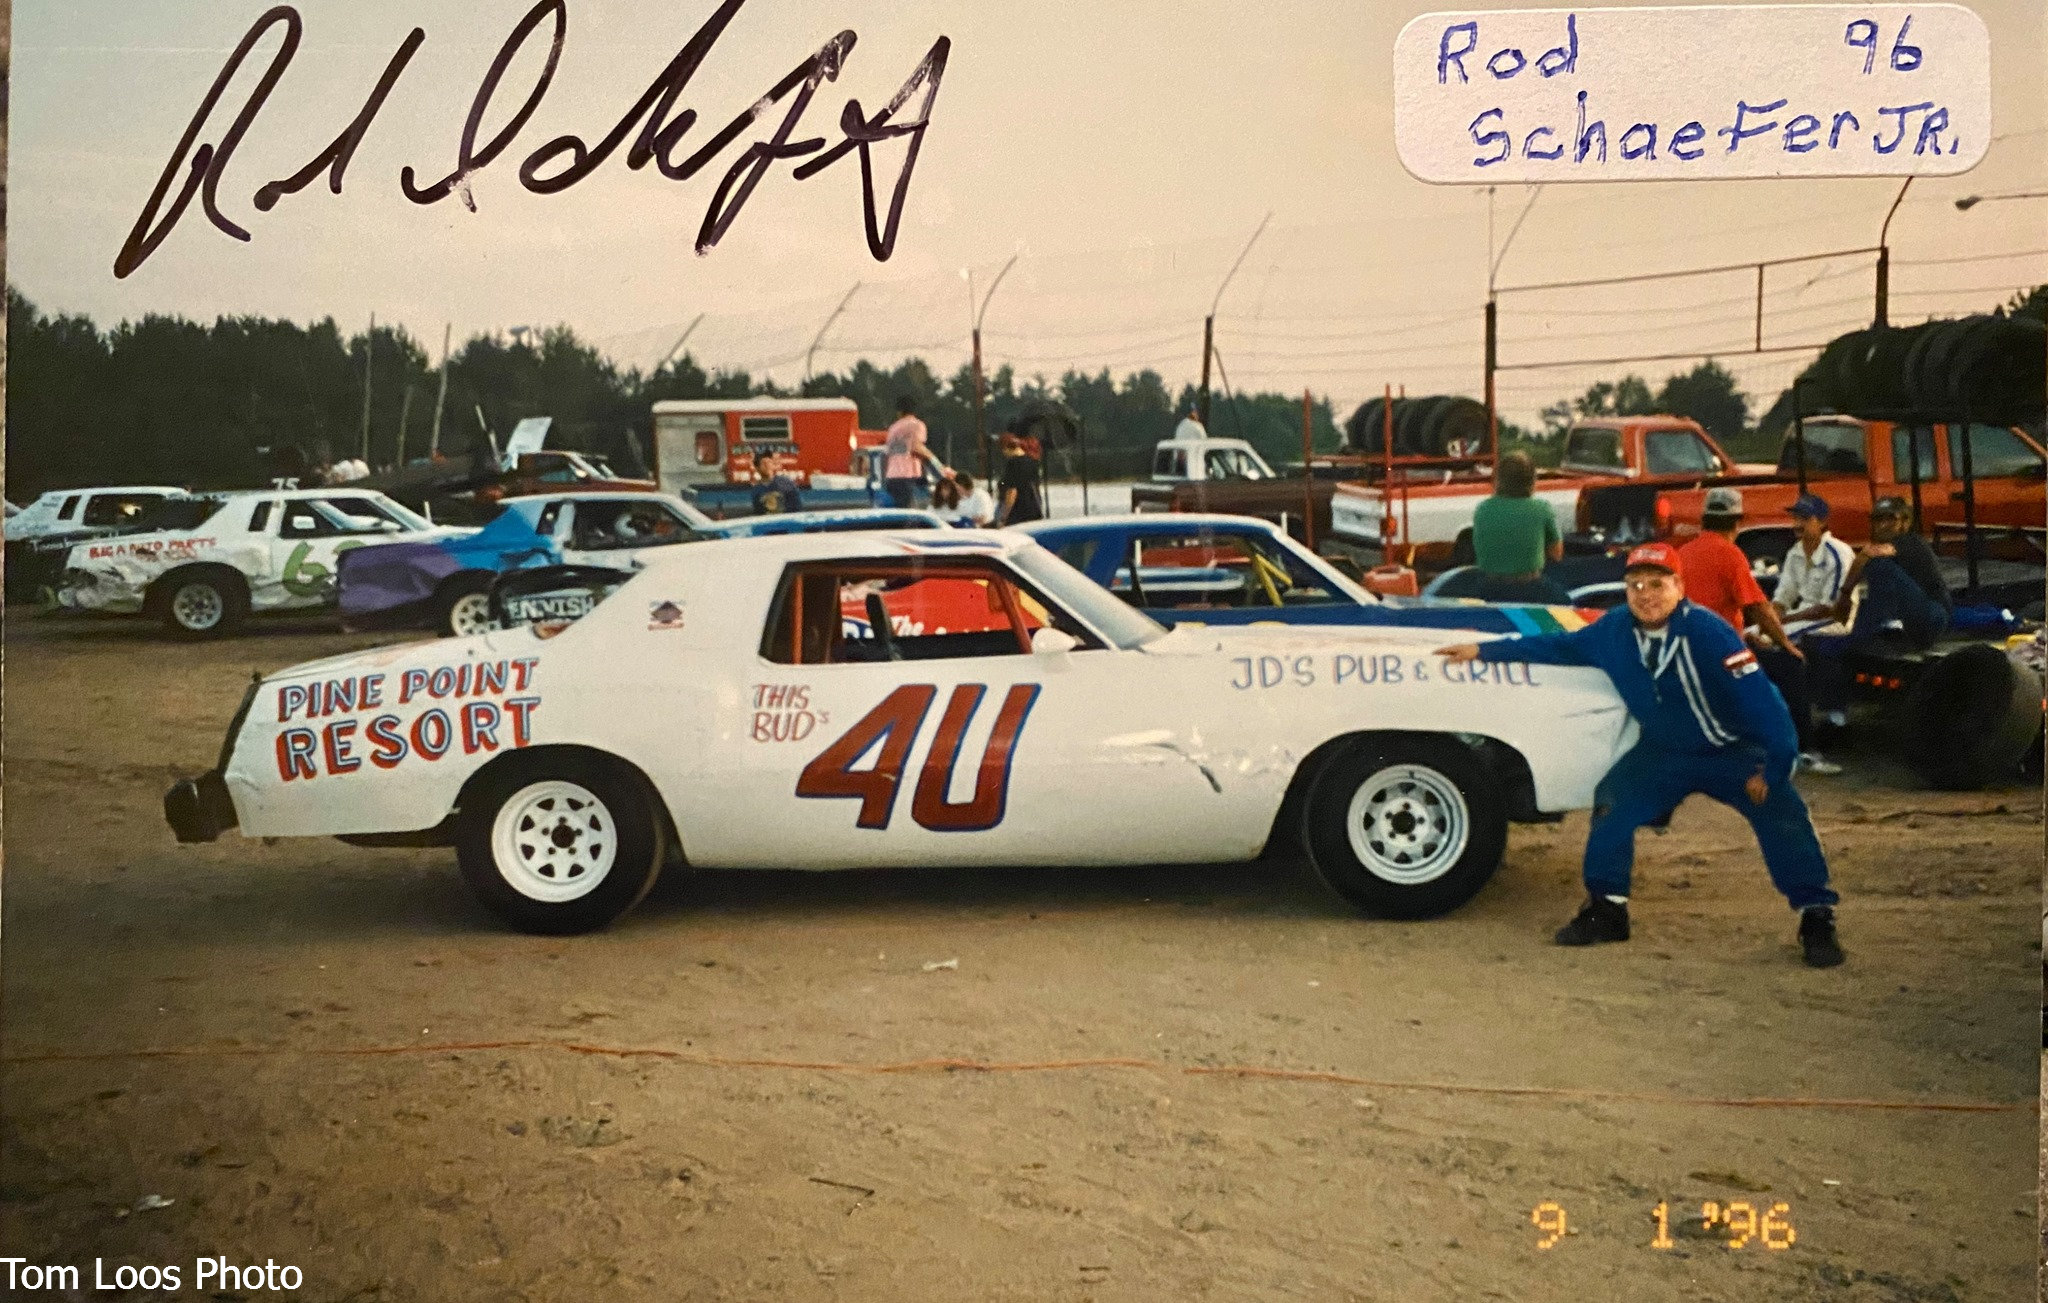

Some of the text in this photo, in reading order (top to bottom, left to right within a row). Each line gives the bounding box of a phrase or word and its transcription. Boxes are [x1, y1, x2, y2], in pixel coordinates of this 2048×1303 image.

[1438, 14, 1923, 84] Rod 96
[278, 657, 540, 723] PINE POINT
[752, 683, 811, 709] THIS
[1232, 654, 1315, 690] JD'S
[1333, 653, 1404, 684] PUB
[1442, 657, 1542, 687] GRILL
[276, 696, 541, 782] RESORT
[794, 682, 1042, 832] 4U
